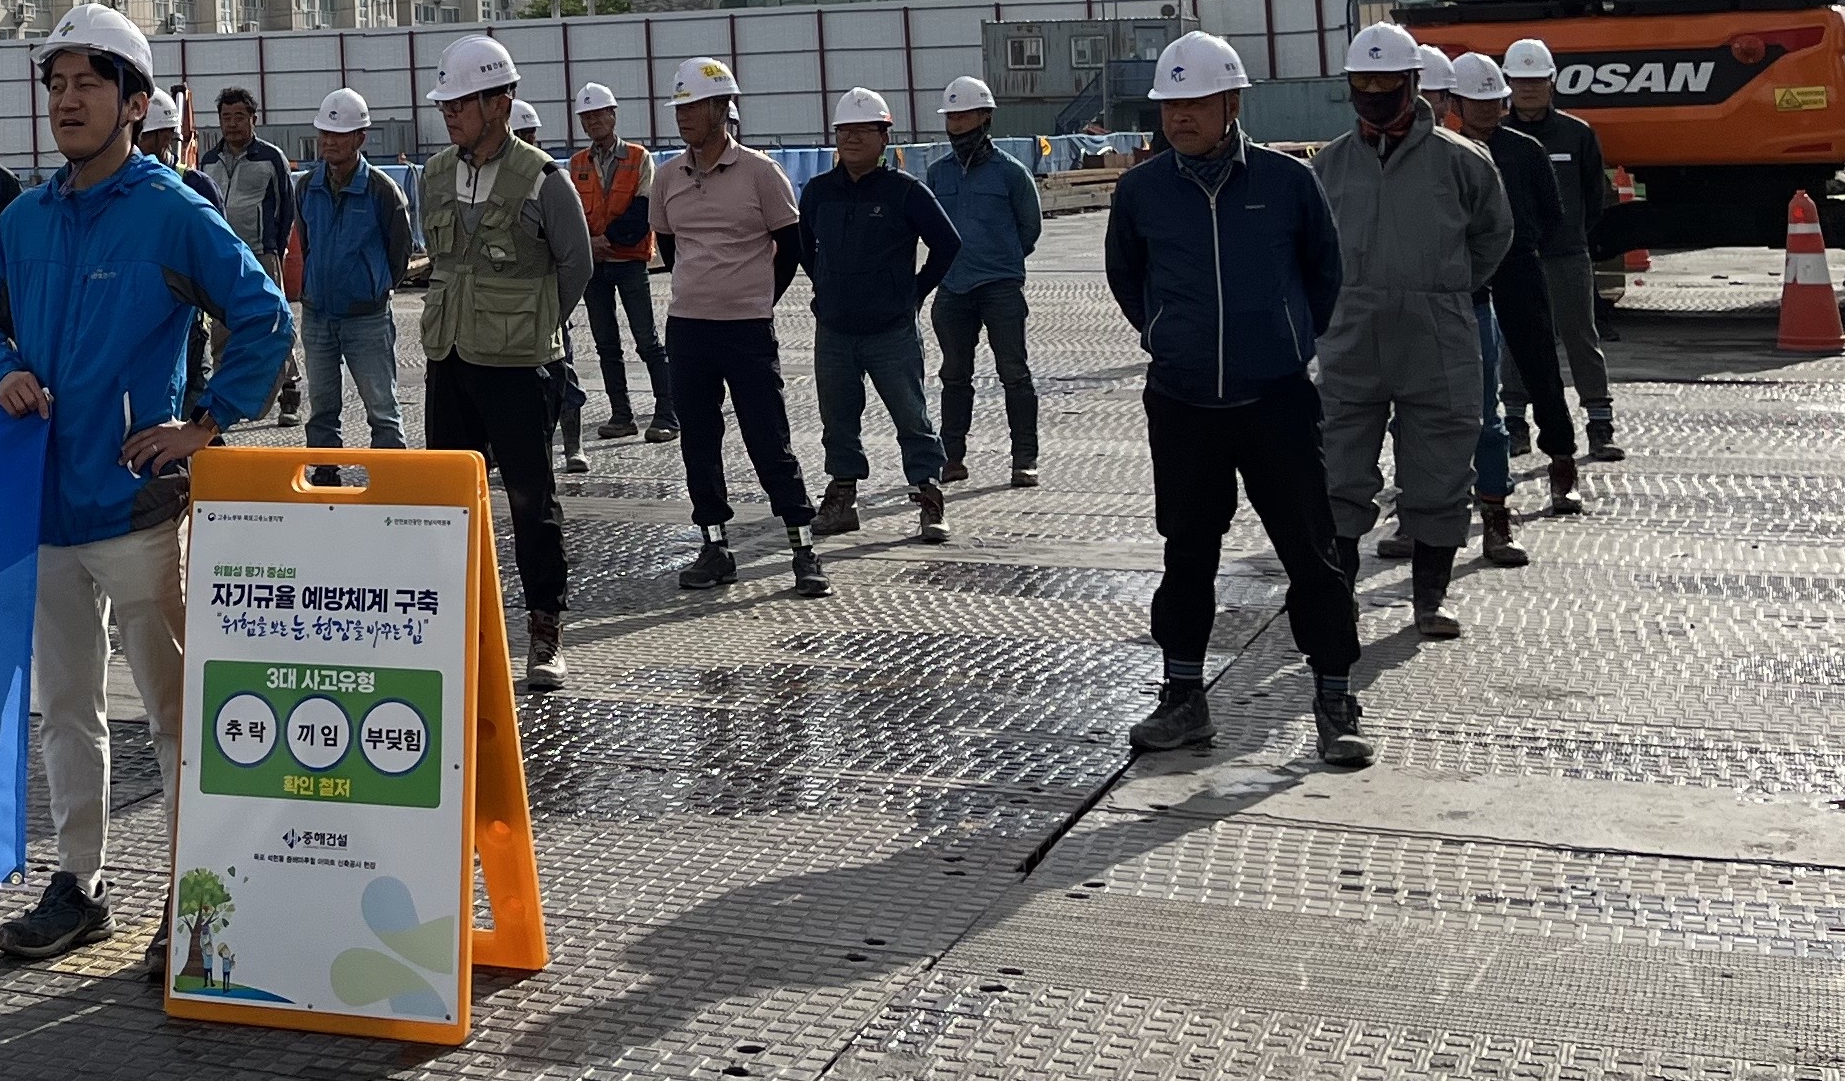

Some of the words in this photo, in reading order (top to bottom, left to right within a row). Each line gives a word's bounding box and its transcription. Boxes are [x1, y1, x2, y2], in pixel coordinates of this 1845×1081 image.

[214, 565, 242, 578] 위험성
[245, 566, 264, 578] 평가
[267, 566, 296, 579] 중심의
[211, 583, 296, 610] 자기규율
[302, 585, 388, 613] 예방체계
[394, 589, 439, 615] 구축
[271, 620, 289, 636] 보는
[291, 616, 310, 641] 눈,
[312, 616, 364, 641] 현장을
[366, 619, 402, 648] 바꾸는
[266, 668, 296, 689] 3대
[301, 670, 375, 693] 사고유형
[365, 728, 421, 752] 부딪힘
[283, 776, 314, 796] 확인
[319, 778, 350, 798] 철저
[302, 831, 348, 847] 중해건설
